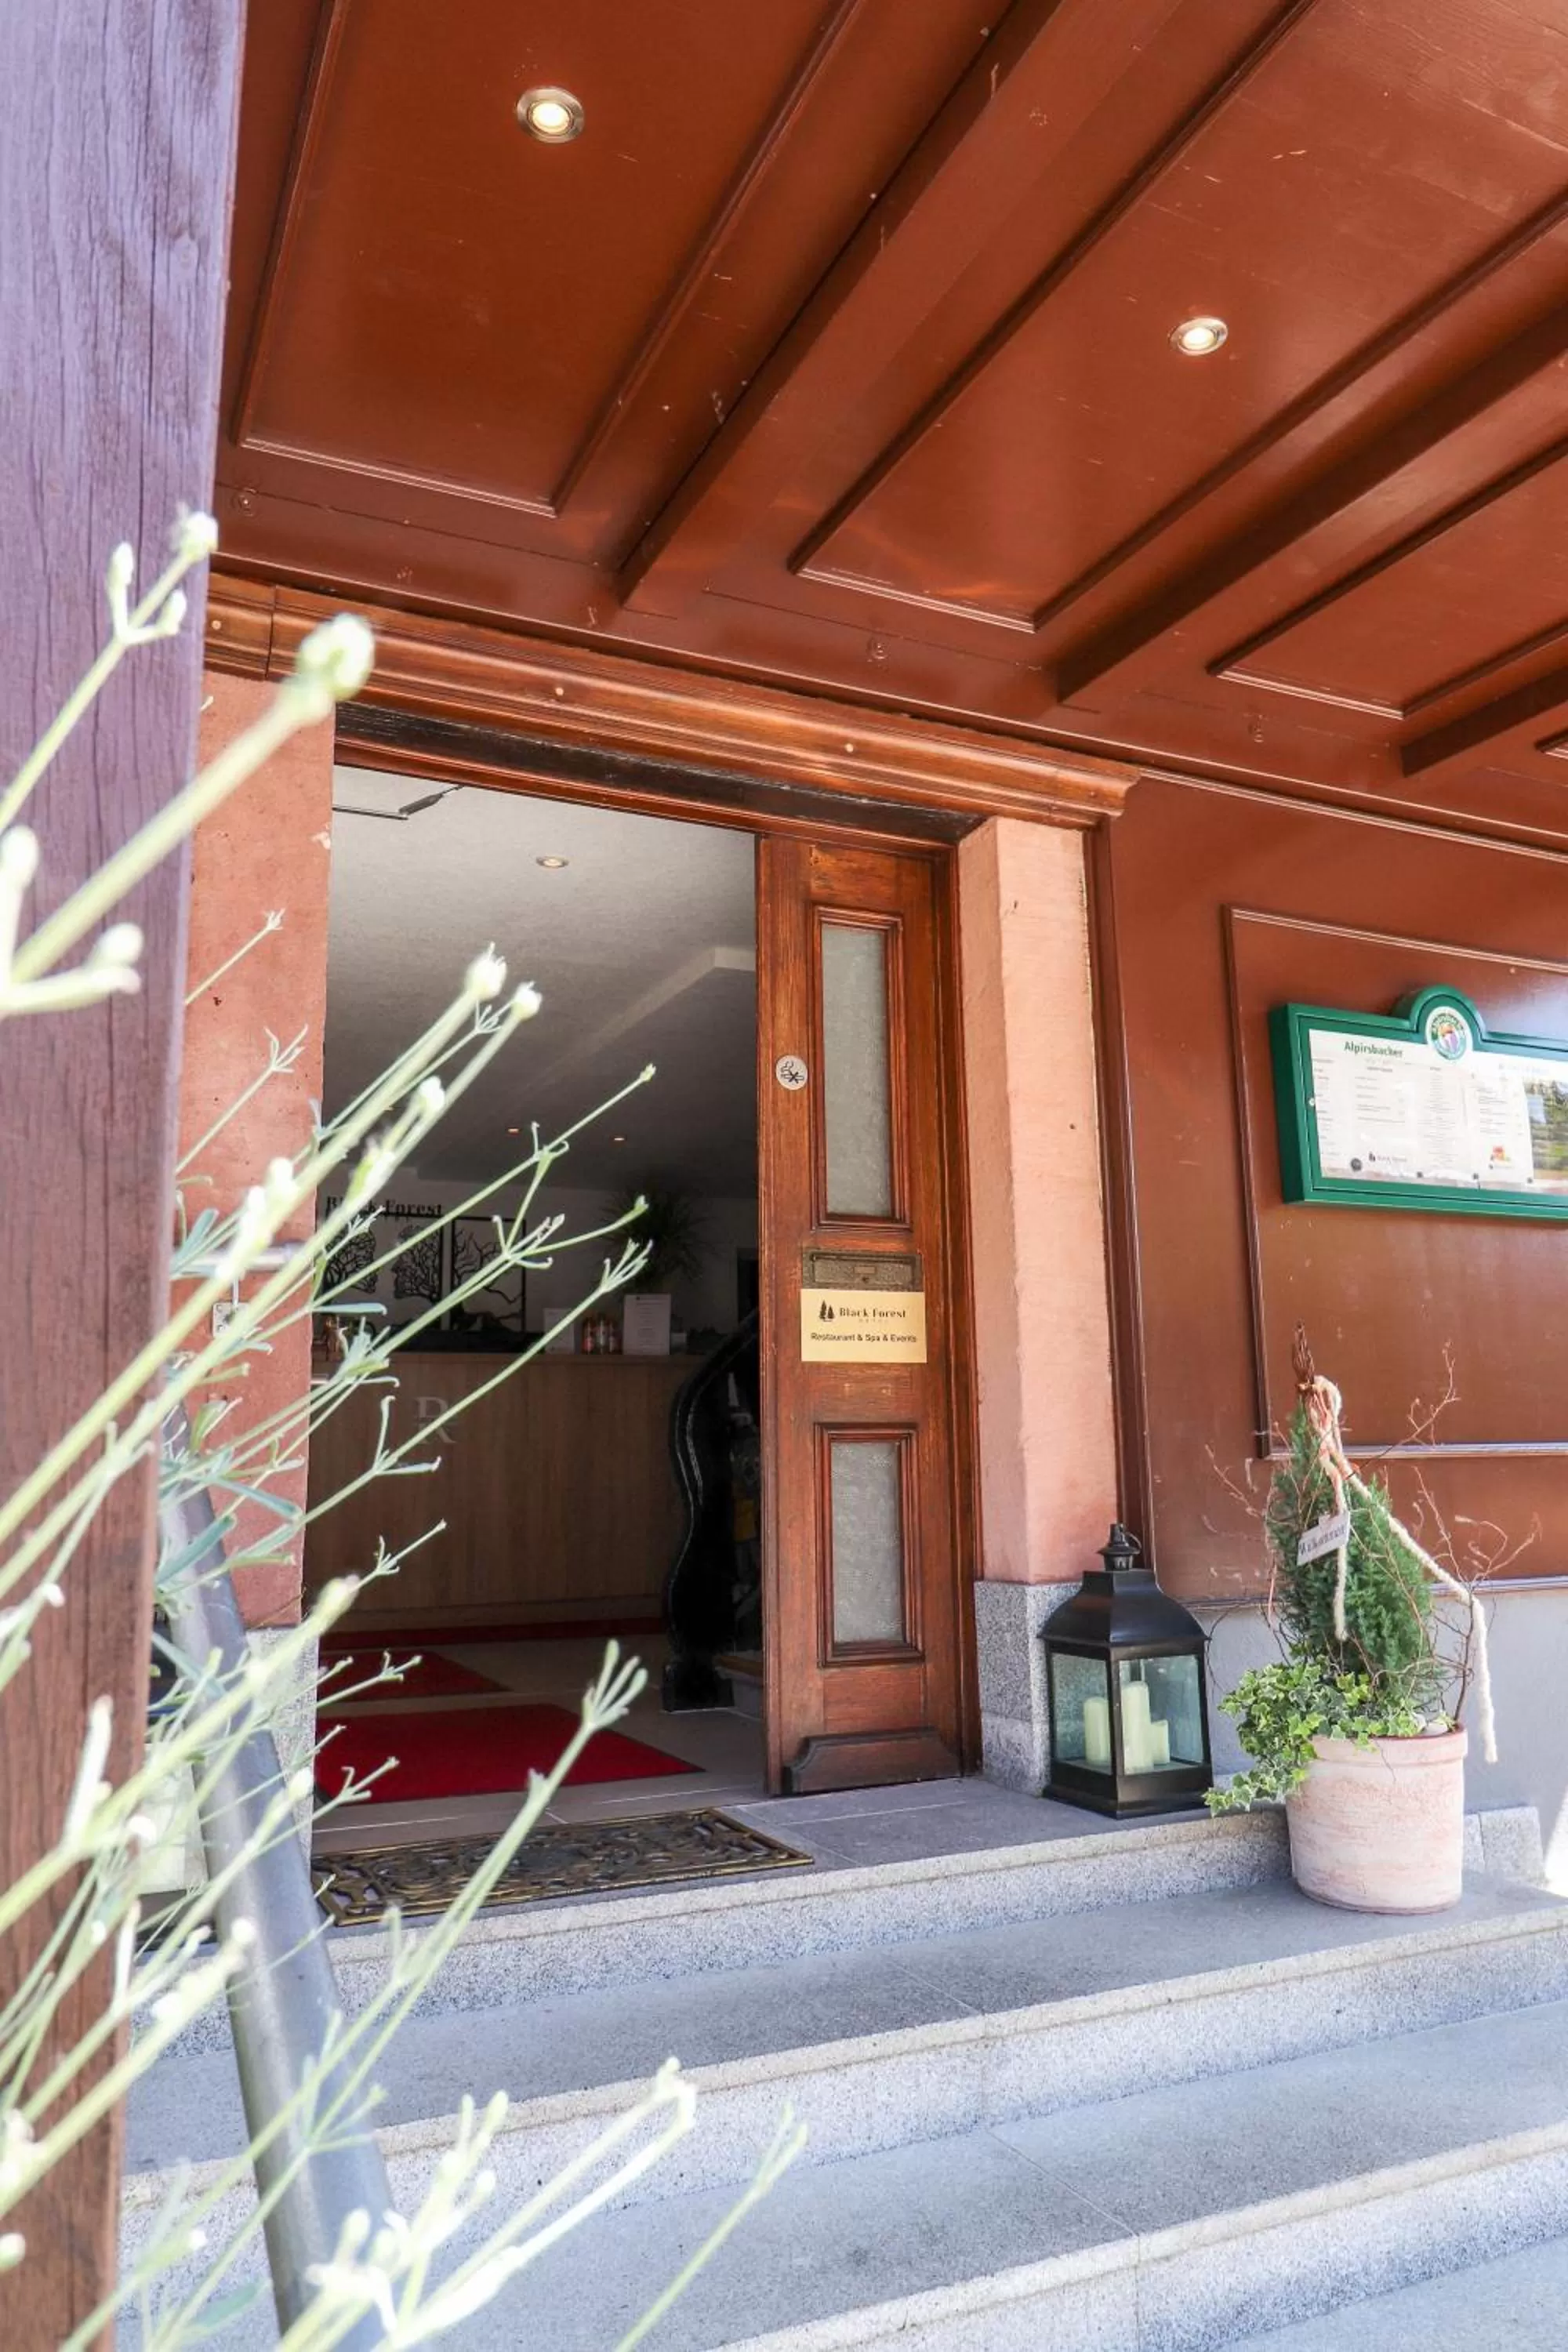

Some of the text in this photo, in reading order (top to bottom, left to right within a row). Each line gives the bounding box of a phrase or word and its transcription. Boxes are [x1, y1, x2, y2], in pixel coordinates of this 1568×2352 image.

[385, 1199, 442, 1216] Forest
[840, 1307, 906, 1318] Black Forest
[811, 1332, 855, 1341] Restaurant
[865, 1334, 880, 1342] Spa
[890, 1334, 917, 1343] Events
